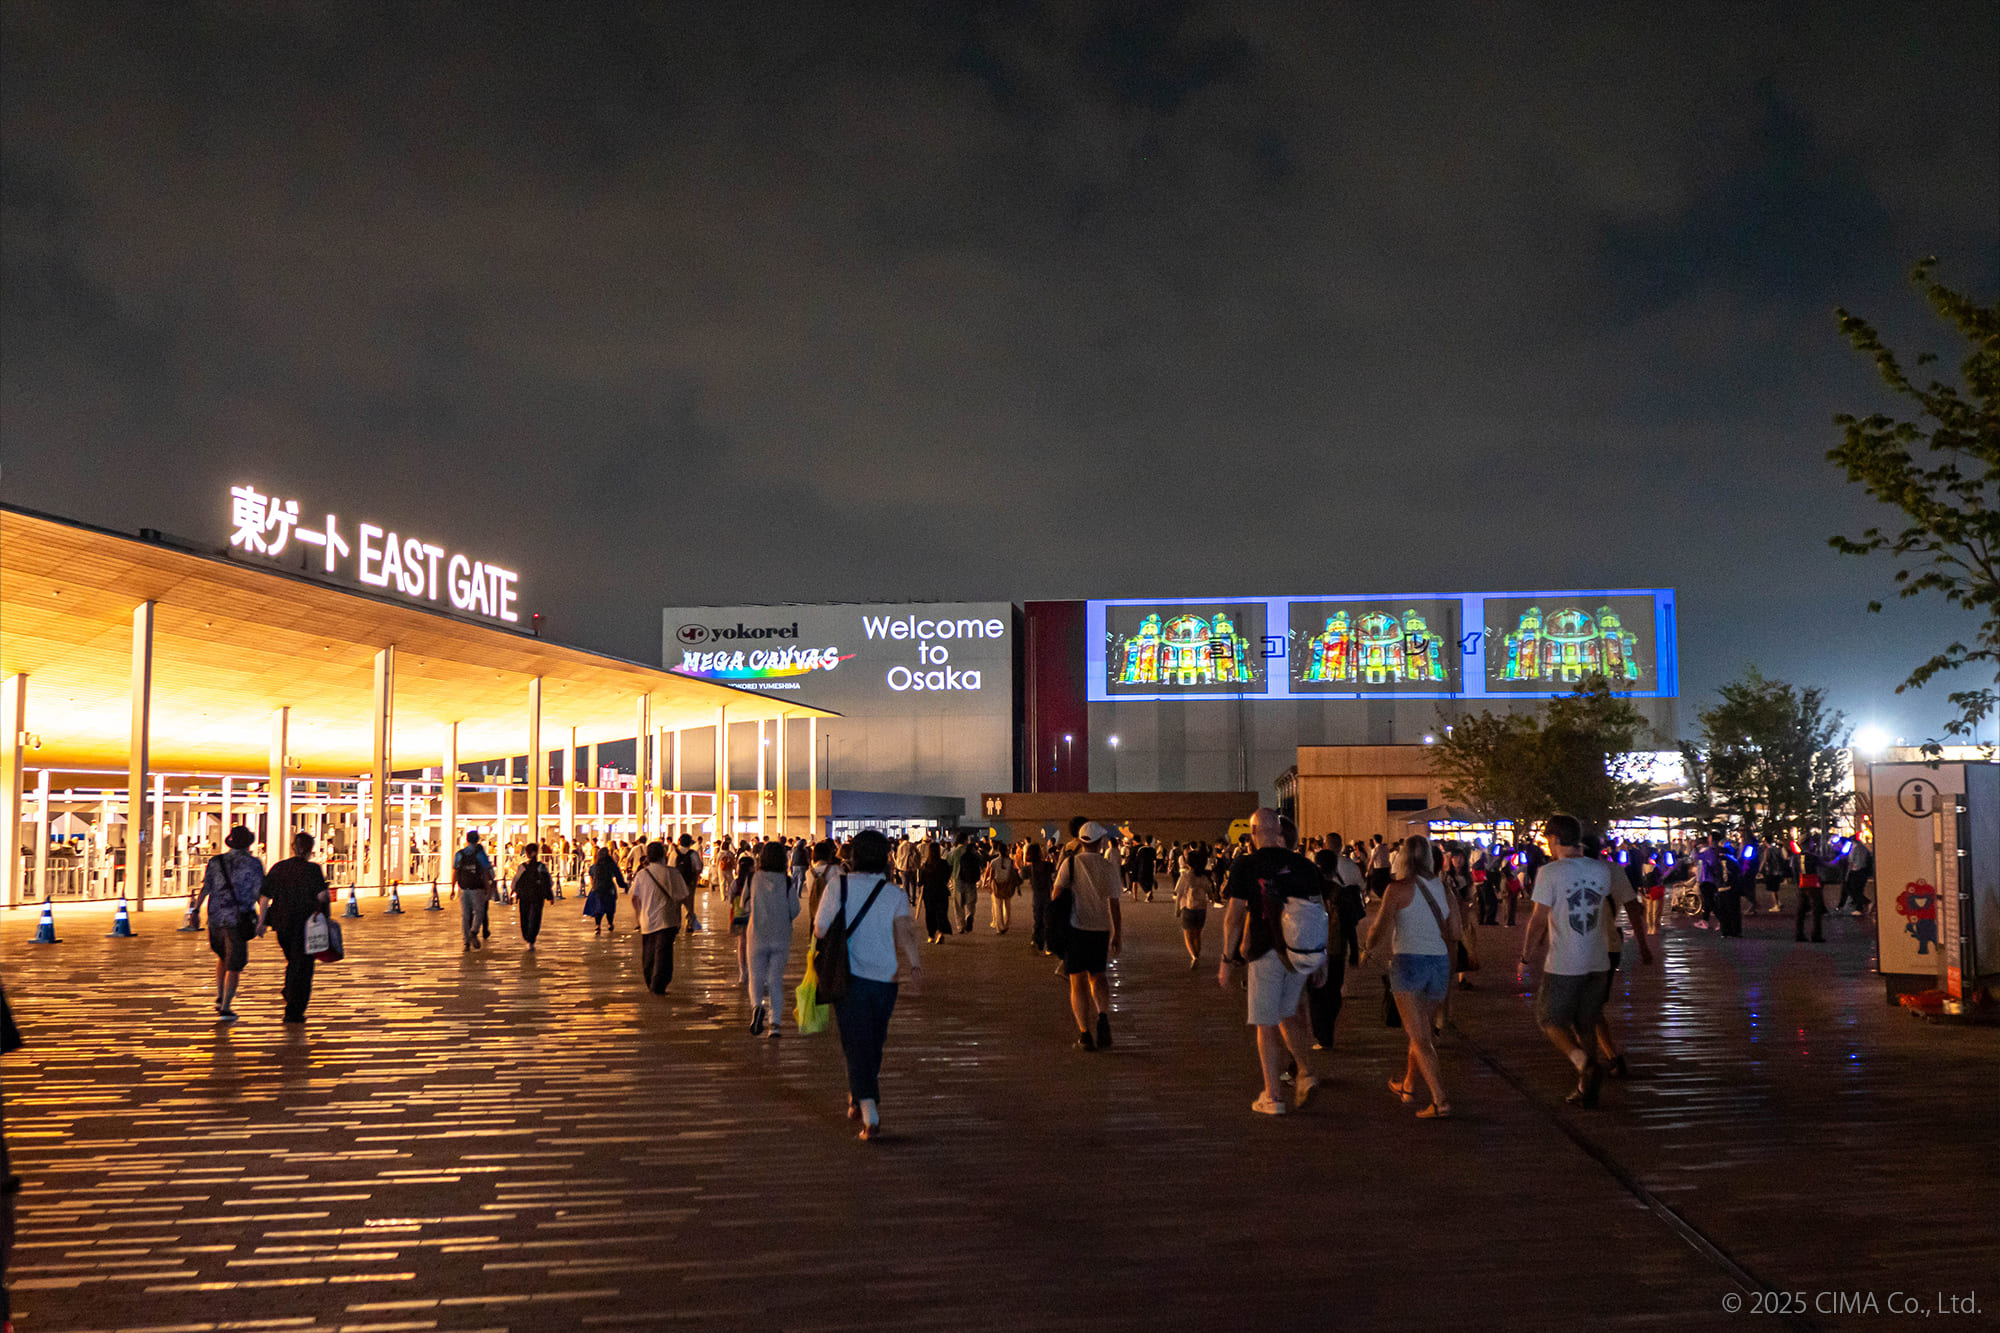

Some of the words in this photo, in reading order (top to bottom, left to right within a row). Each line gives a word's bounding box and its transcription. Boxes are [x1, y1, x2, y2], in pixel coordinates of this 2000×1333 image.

[230, 485, 350, 572] 東ゲート
[359, 523, 444, 600] EAST
[448, 554, 519, 622] GATE
[711, 622, 800, 642] yokorei
[862, 615, 1005, 640] Welcome
[682, 648, 745, 672] MEGA
[749, 645, 839, 671] CANVAS
[918, 641, 948, 665] to
[759, 682, 801, 690] YUMESHIMA
[887, 665, 981, 692] Osaka
